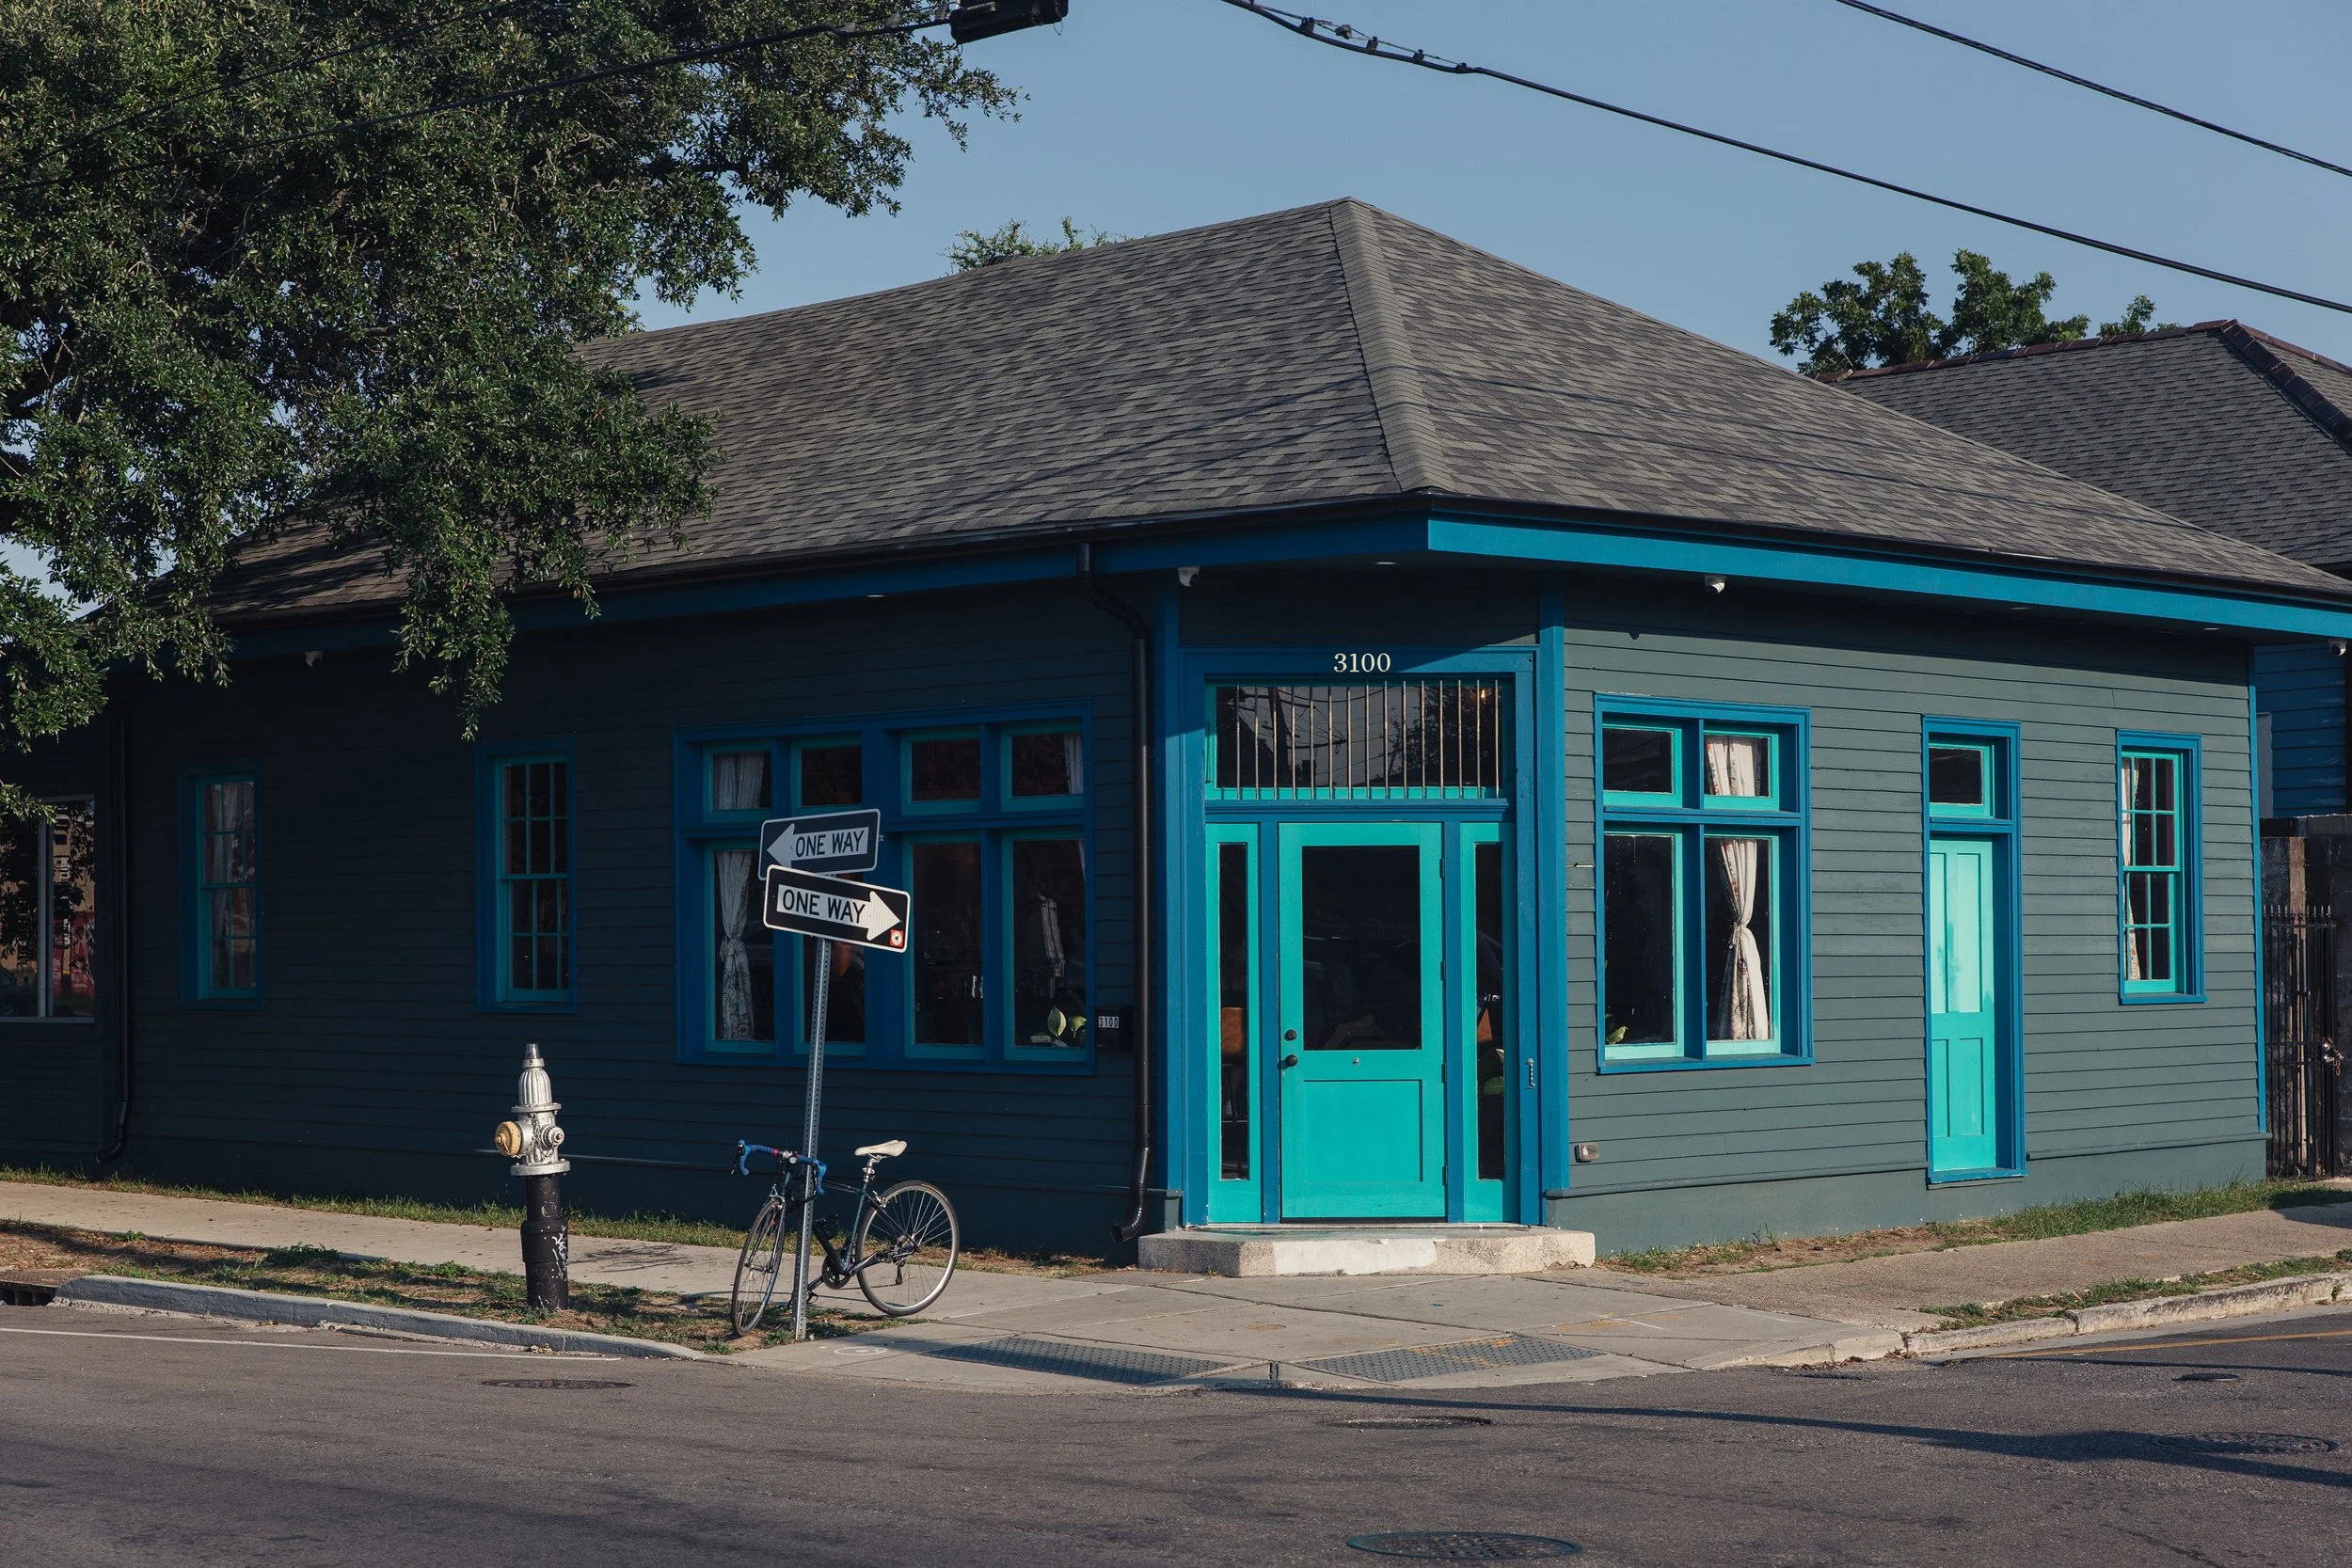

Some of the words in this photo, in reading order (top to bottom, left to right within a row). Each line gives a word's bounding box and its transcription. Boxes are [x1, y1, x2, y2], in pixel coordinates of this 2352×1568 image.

[1333, 653, 1391, 673] 3100
[795, 834, 826, 857] ONE
[832, 830, 865, 854] WAY
[782, 889, 820, 916] ONE
[827, 896, 866, 924] WAY
[1099, 1017, 1119, 1028] 3100
